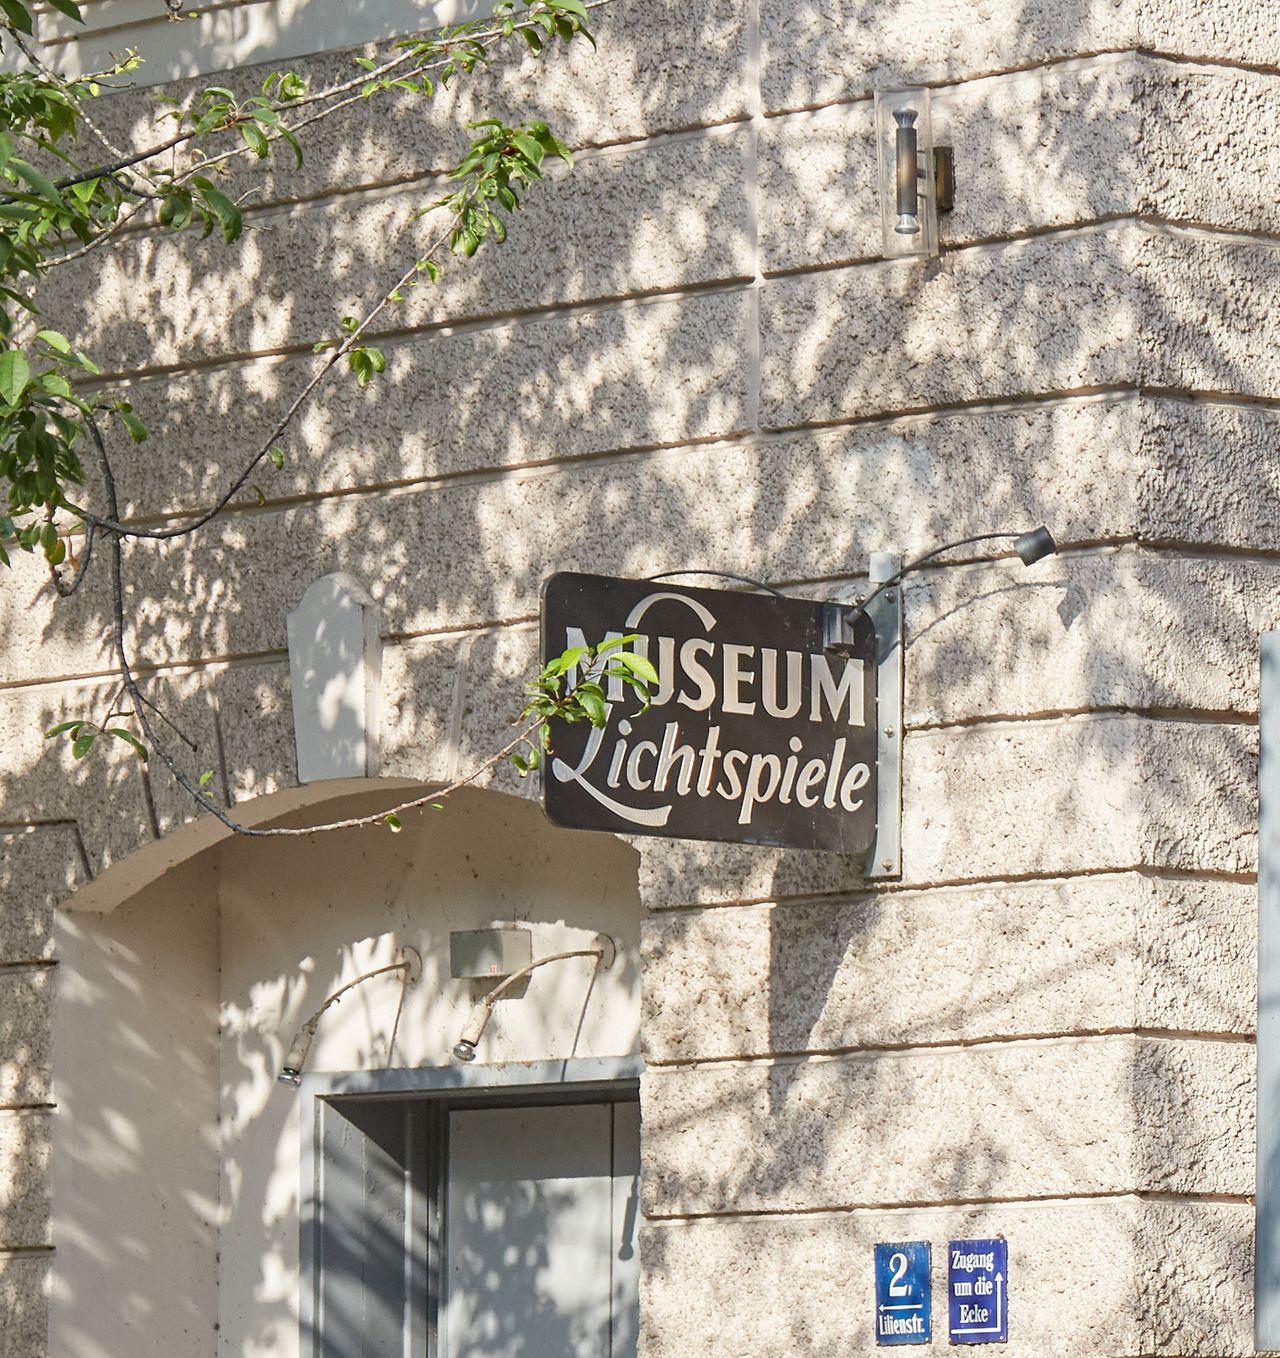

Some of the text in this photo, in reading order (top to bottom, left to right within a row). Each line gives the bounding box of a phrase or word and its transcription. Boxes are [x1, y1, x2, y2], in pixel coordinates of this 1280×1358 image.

[565, 626, 866, 727] MUSEUM
[552, 702, 870, 827] Lichtspiele
[951, 1250, 995, 1272] Zugang
[954, 1276, 993, 1297] um die
[879, 1313, 926, 1336] Lilienstr.
[959, 1303, 989, 1324] Ecke
